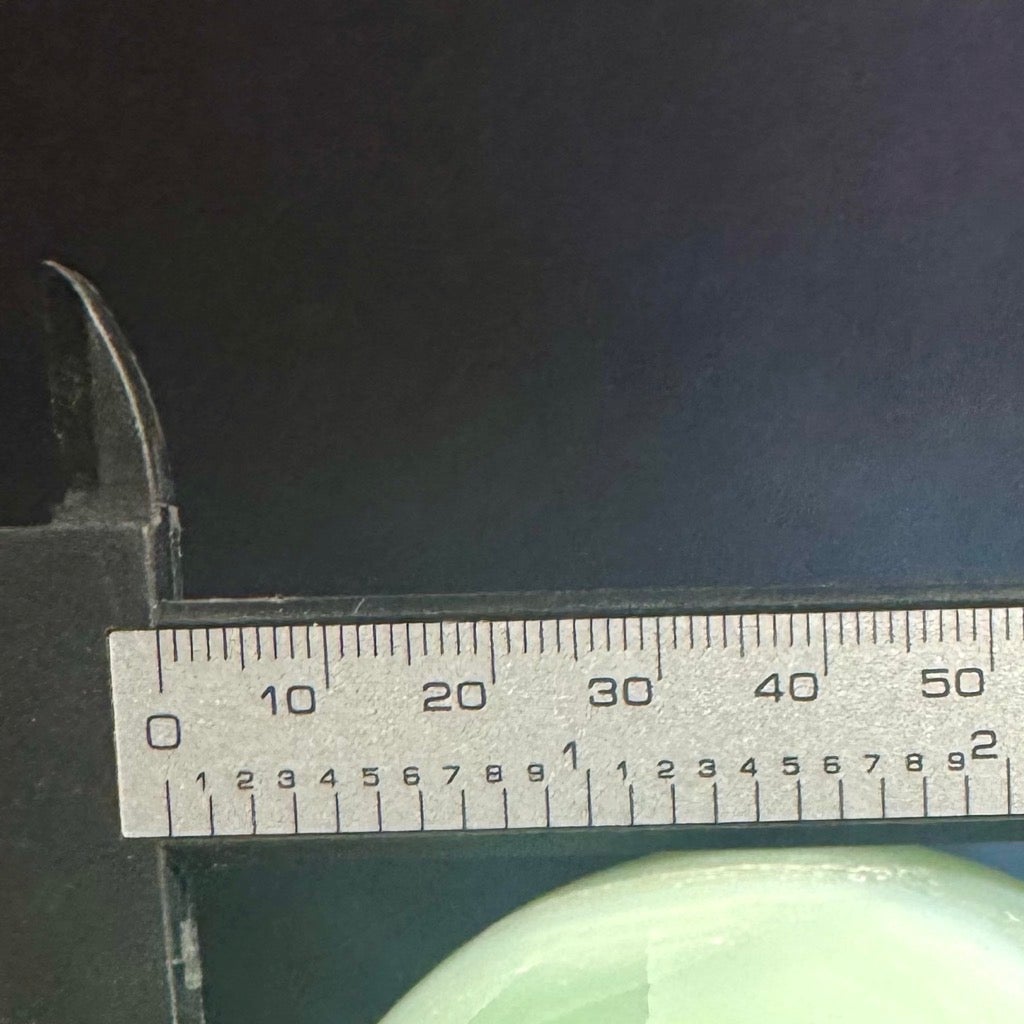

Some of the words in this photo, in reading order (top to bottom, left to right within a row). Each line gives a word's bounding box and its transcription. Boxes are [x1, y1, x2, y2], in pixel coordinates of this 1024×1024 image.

[146, 714, 181, 749] 0
[261, 685, 316, 715] 10
[423, 682, 486, 711] 20
[588, 677, 653, 706] 30
[754, 672, 819, 702] 40
[921, 668, 985, 698] 50
[196, 772, 206, 791] 1
[237, 771, 254, 789] 2
[278, 770, 295, 788] 3
[320, 768, 337, 788] 4
[362, 768, 380, 787] 5
[403, 766, 420, 786] 6
[442, 766, 460, 784] 7
[485, 765, 502, 783] 8
[527, 764, 545, 782] 9
[562, 741, 578, 770] 1
[616, 760, 628, 780] 1
[657, 759, 675, 779] 2
[698, 759, 716, 777] 3
[740, 757, 758, 776] 4
[782, 756, 800, 775] 5
[823, 755, 841, 774] 6
[864, 754, 880, 773] 7
[906, 753, 924, 771] 8
[947, 752, 965, 770] 9
[970, 730, 998, 759] 2
